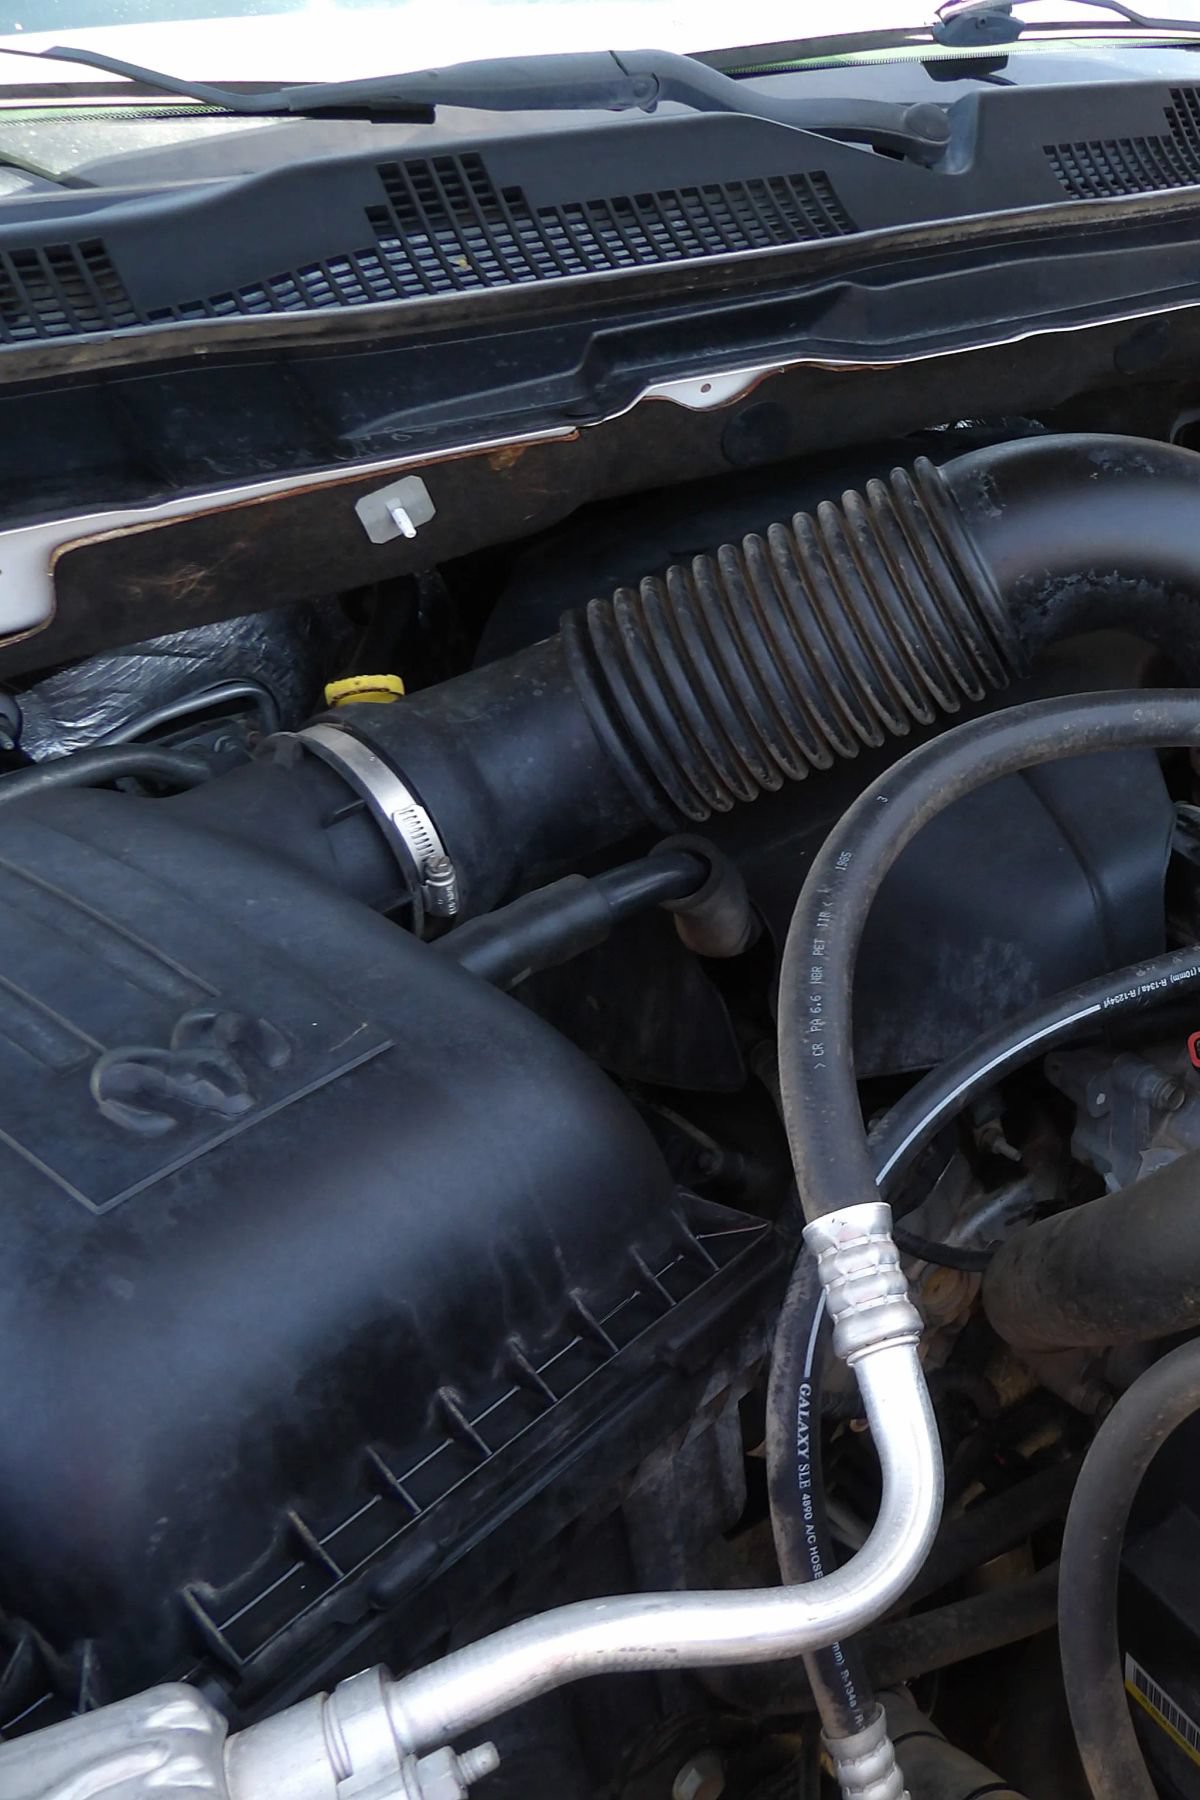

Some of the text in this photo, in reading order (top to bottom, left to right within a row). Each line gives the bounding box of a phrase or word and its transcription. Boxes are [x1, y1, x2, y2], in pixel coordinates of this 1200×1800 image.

[812, 938, 825, 956] PET
[809, 966, 825, 985] NBR
[1170, 966, 1197, 983] (10mm)
[1141, 978, 1167, 992] R-134a
[809, 994, 822, 1014] 6.6
[1103, 989, 1136, 1008] R-1234yf
[810, 1018, 826, 1032] PA
[812, 1042, 825, 1057] CR
[797, 1383, 824, 1579] GALAXY SLE 4890 A/C HOSE
[841, 1669, 857, 1708] R-134a
